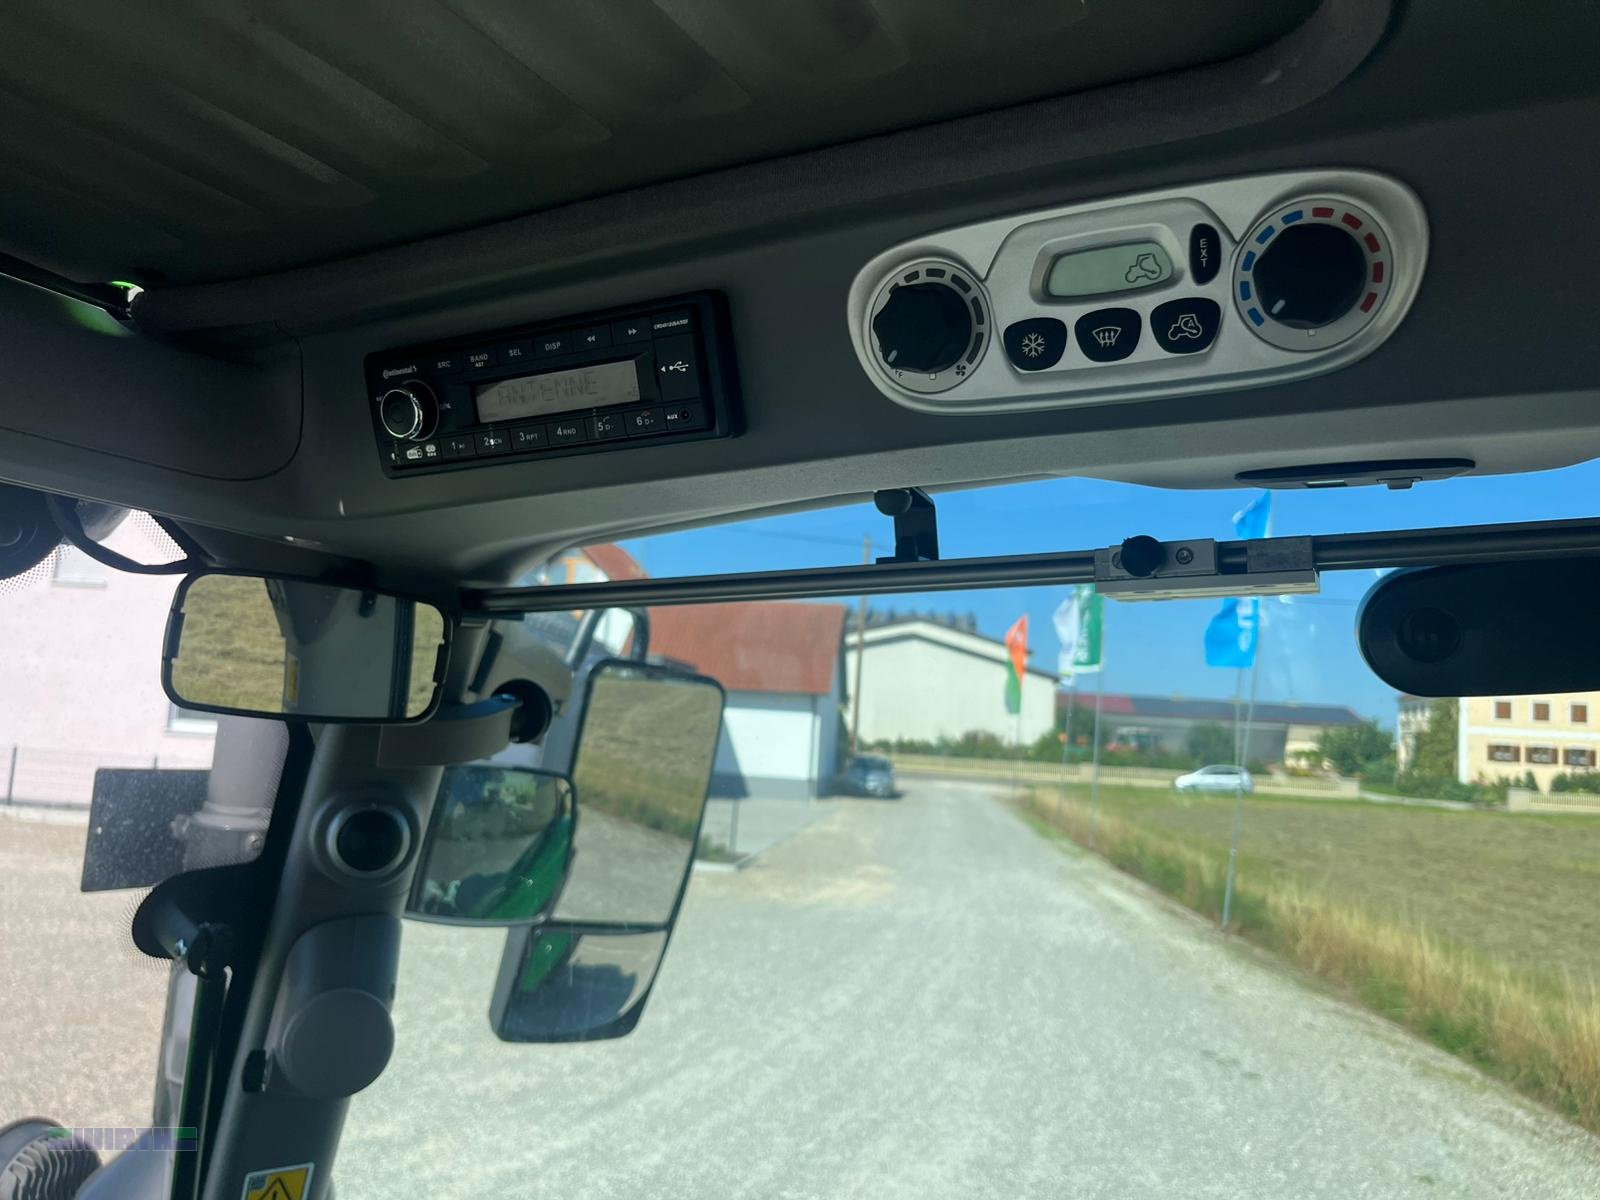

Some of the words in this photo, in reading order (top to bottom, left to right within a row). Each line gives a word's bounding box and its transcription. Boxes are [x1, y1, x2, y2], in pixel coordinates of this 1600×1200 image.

[1199, 237, 1209, 268] EXT
[545, 341, 561, 351] DISP
[508, 348, 522, 357] SEL
[470, 353, 488, 363] BAND
[437, 361, 451, 369] SRC
[635, 416, 643, 426] 6
[666, 413, 679, 421] AUX
[556, 426, 563, 436] 4
[563, 427, 577, 436] RND
[597, 421, 604, 431] 5
[483, 436, 490, 446] 2
[519, 431, 526, 441] 3
[526, 432, 540, 441] RPT
